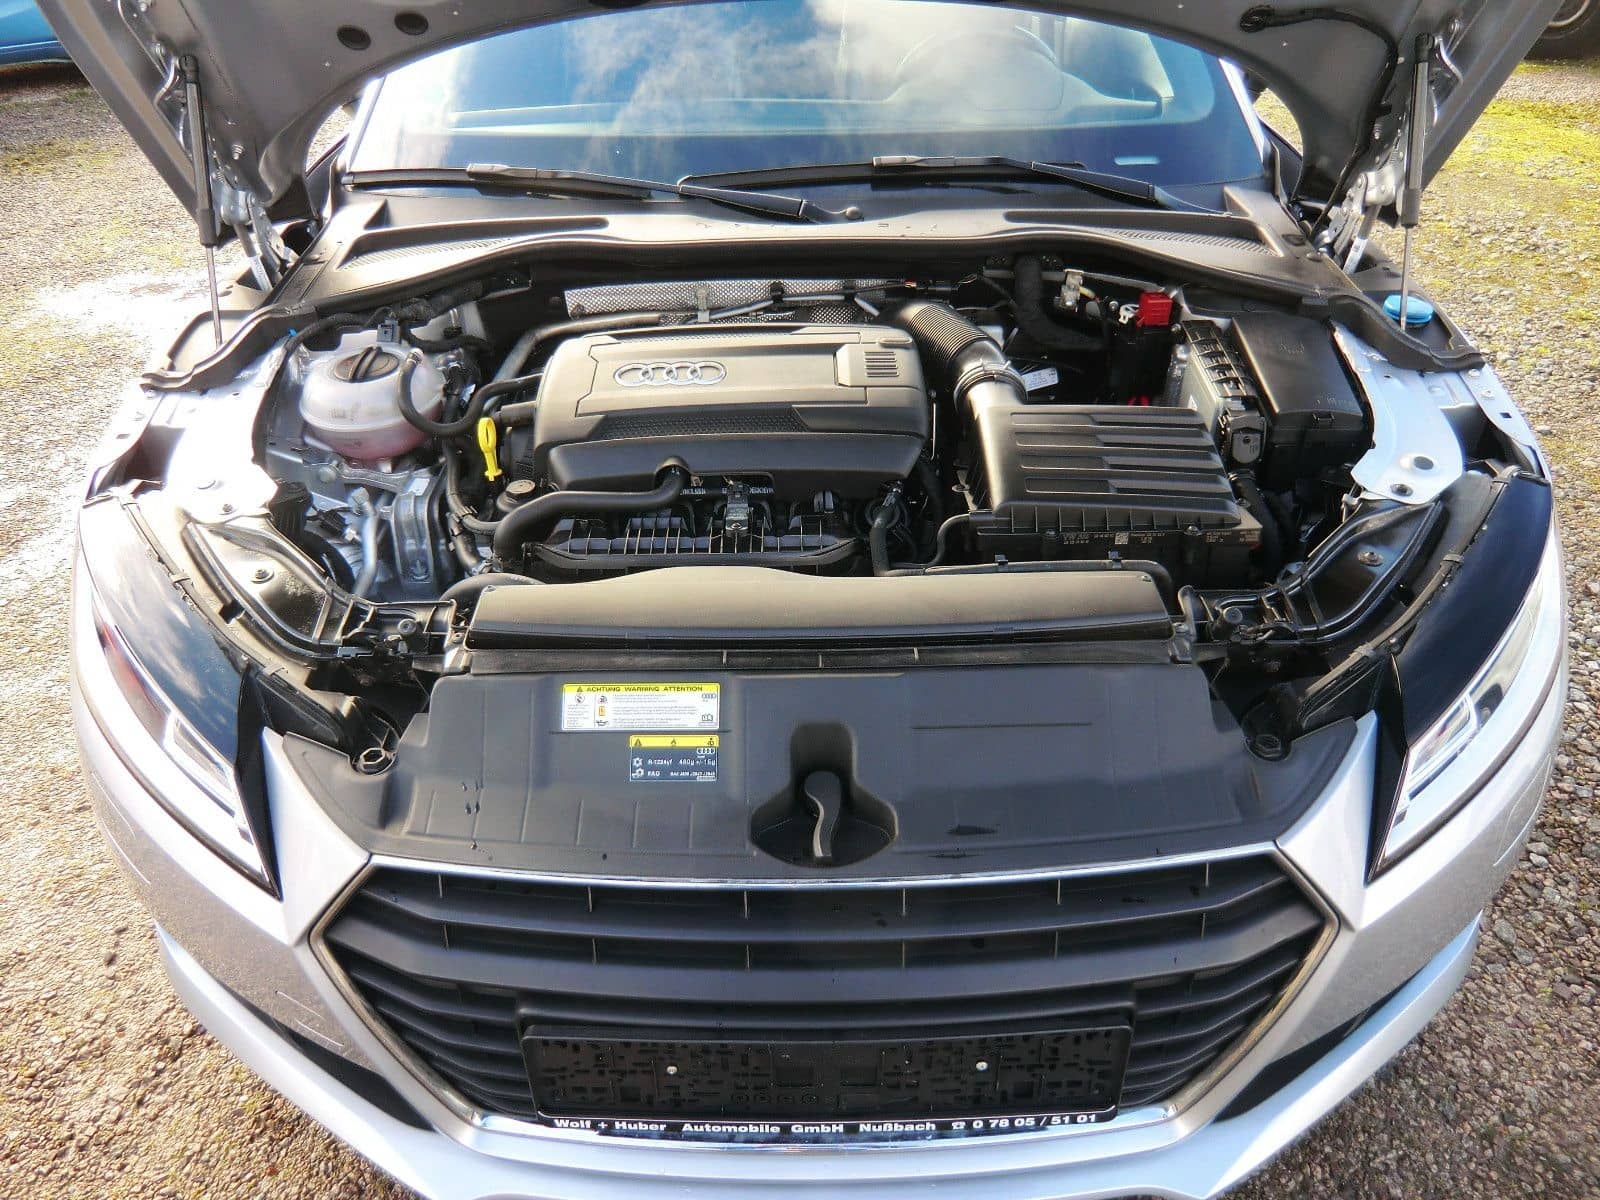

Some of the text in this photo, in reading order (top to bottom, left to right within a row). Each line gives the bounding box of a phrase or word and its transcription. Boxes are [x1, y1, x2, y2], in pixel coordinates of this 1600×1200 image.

[554, 1118, 591, 1129] Wolf
[597, 1121, 608, 1129] +
[614, 1121, 667, 1131] Huber
[681, 1122, 781, 1133] Automobile
[790, 1123, 844, 1133] GmbH
[859, 1122, 936, 1133] Nußbach
[972, 1119, 983, 1129] 0
[989, 1118, 1010, 1128] 78
[1014, 1117, 1036, 1127] 05
[1051, 1115, 1070, 1125] 51
[1077, 1113, 1096, 1124] 01
